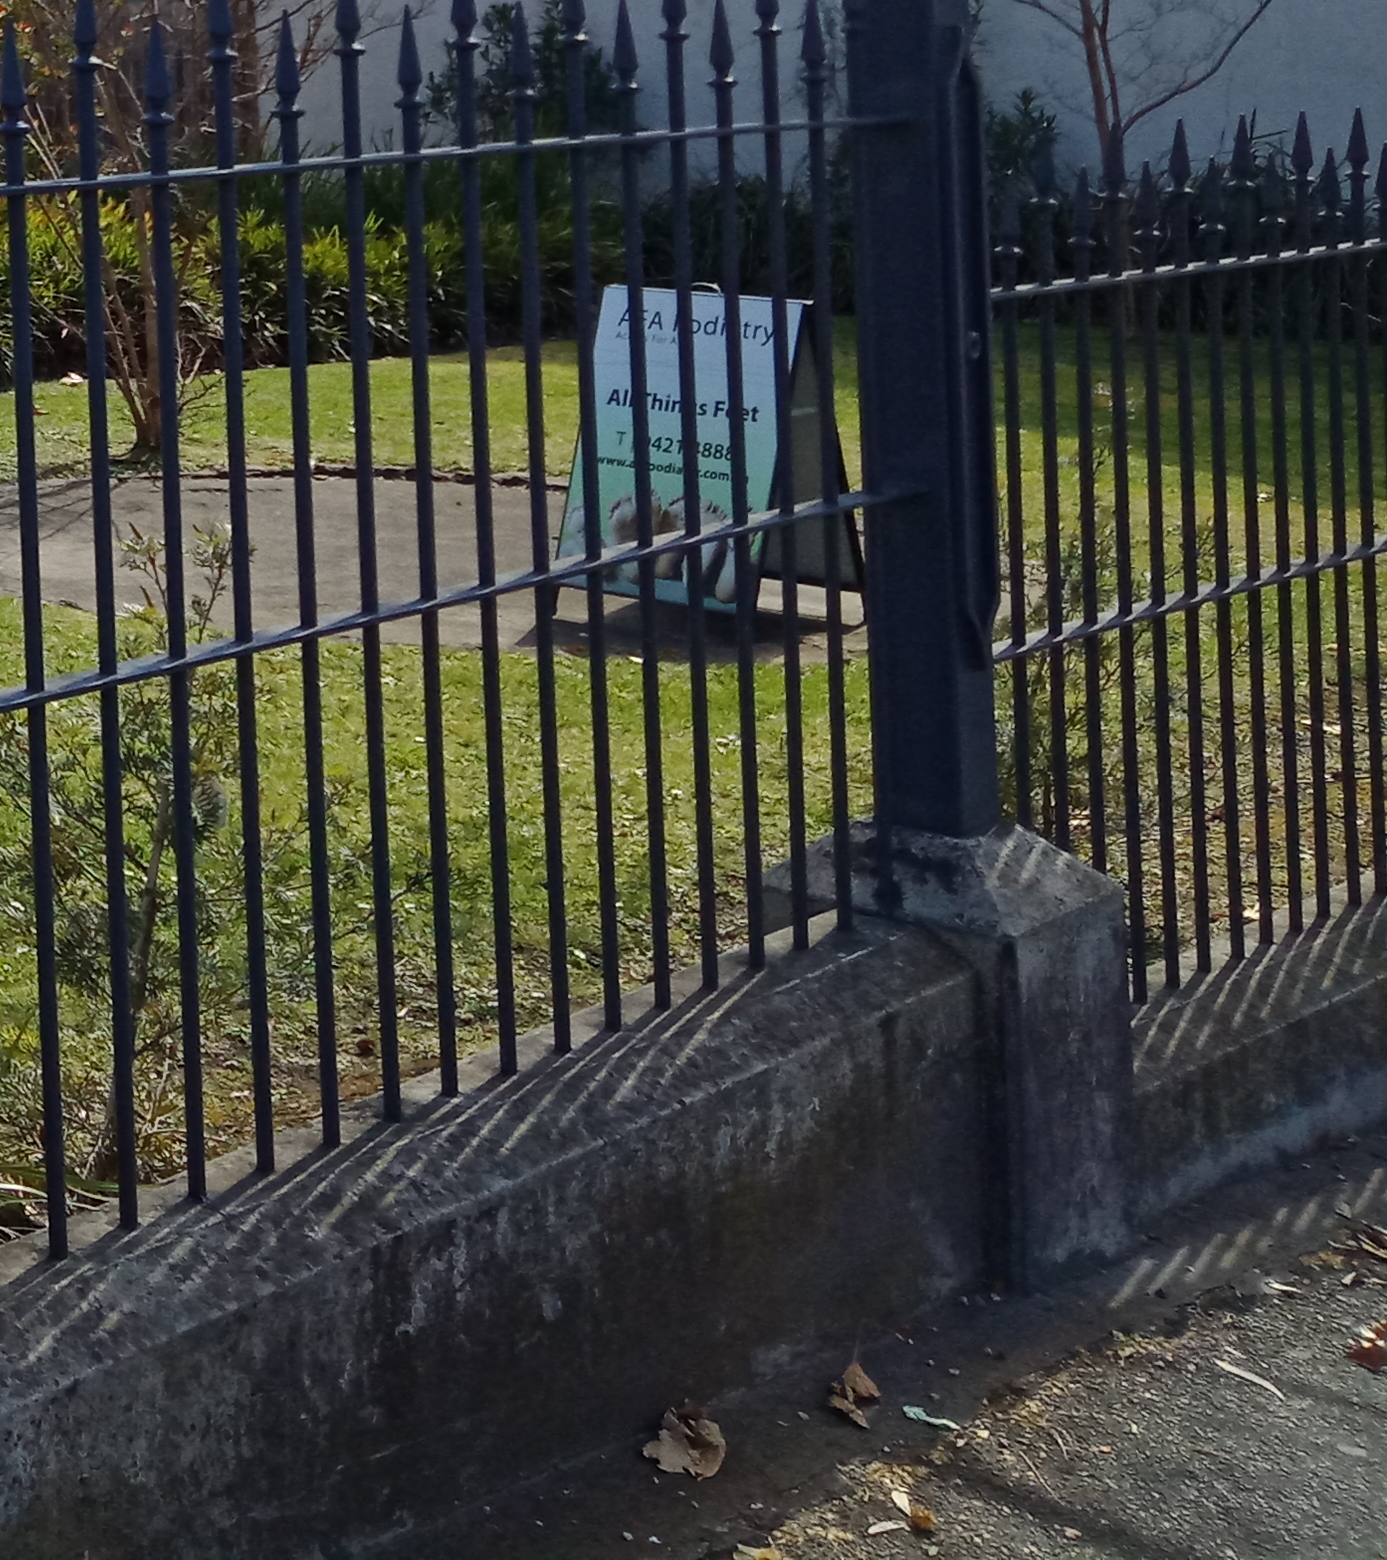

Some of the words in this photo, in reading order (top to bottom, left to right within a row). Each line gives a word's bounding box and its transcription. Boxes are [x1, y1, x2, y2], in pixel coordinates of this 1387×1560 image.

[672, 315, 774, 347] oditry
[641, 392, 707, 417] hins
[712, 400, 759, 423] Fet
[642, 436, 684, 455] 421
[691, 441, 735, 461] 888
